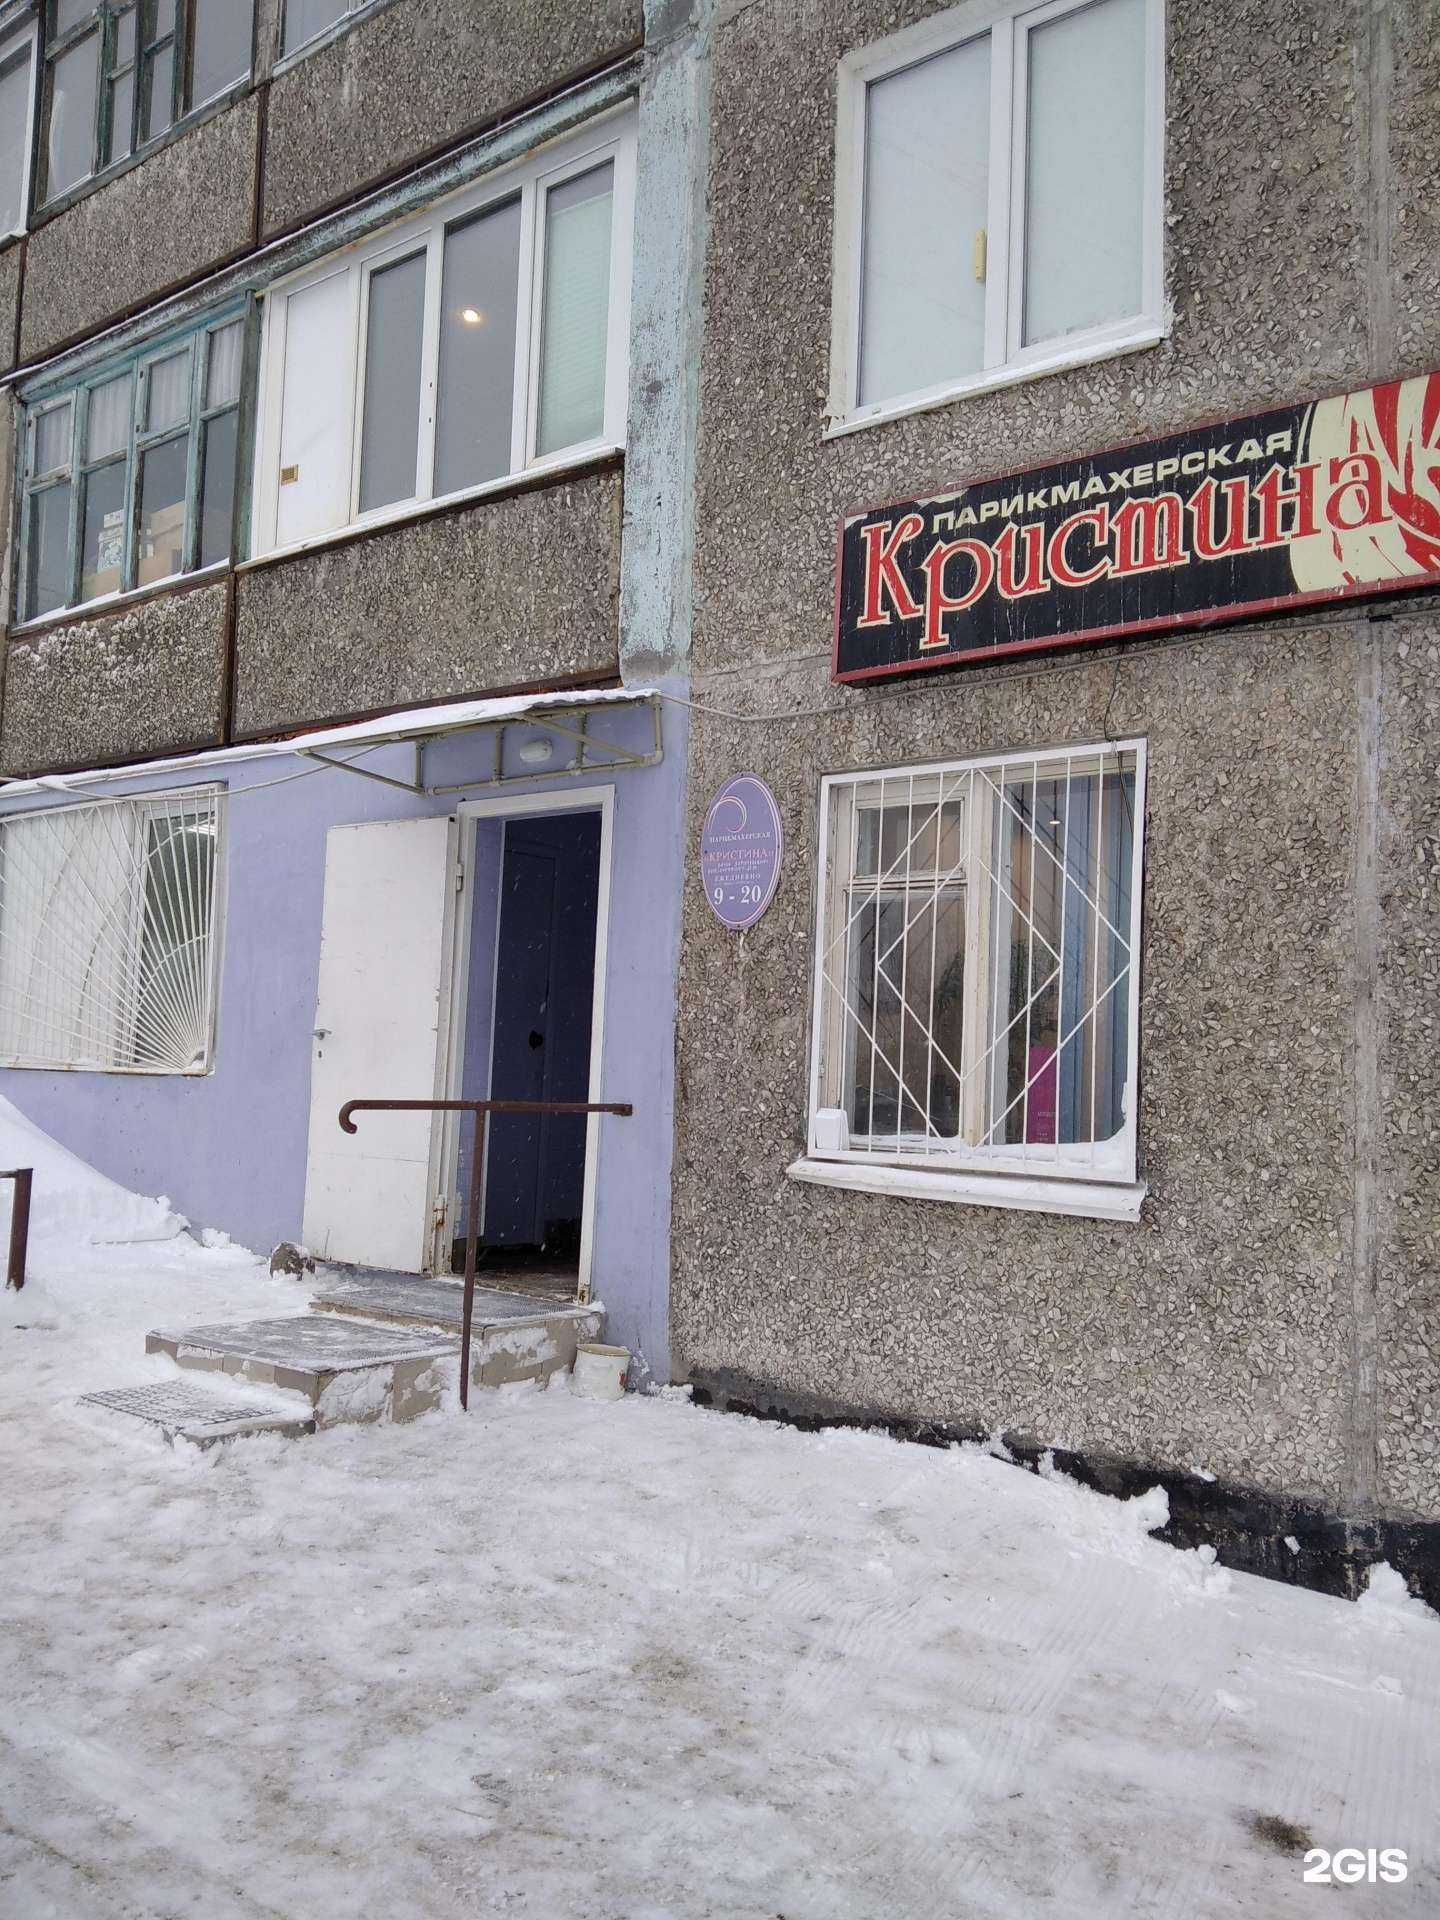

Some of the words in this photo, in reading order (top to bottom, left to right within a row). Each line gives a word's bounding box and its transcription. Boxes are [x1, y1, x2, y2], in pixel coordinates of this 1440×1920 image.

[933, 430, 1293, 534] ПАРИКМАХЕРСКАЯ
[856, 451, 1393, 650] Кристина
[710, 831, 771, 843] ПАРИКМАХЕРСКАЯ
[713, 887, 724, 905] 9
[740, 884, 762, 904] 20
